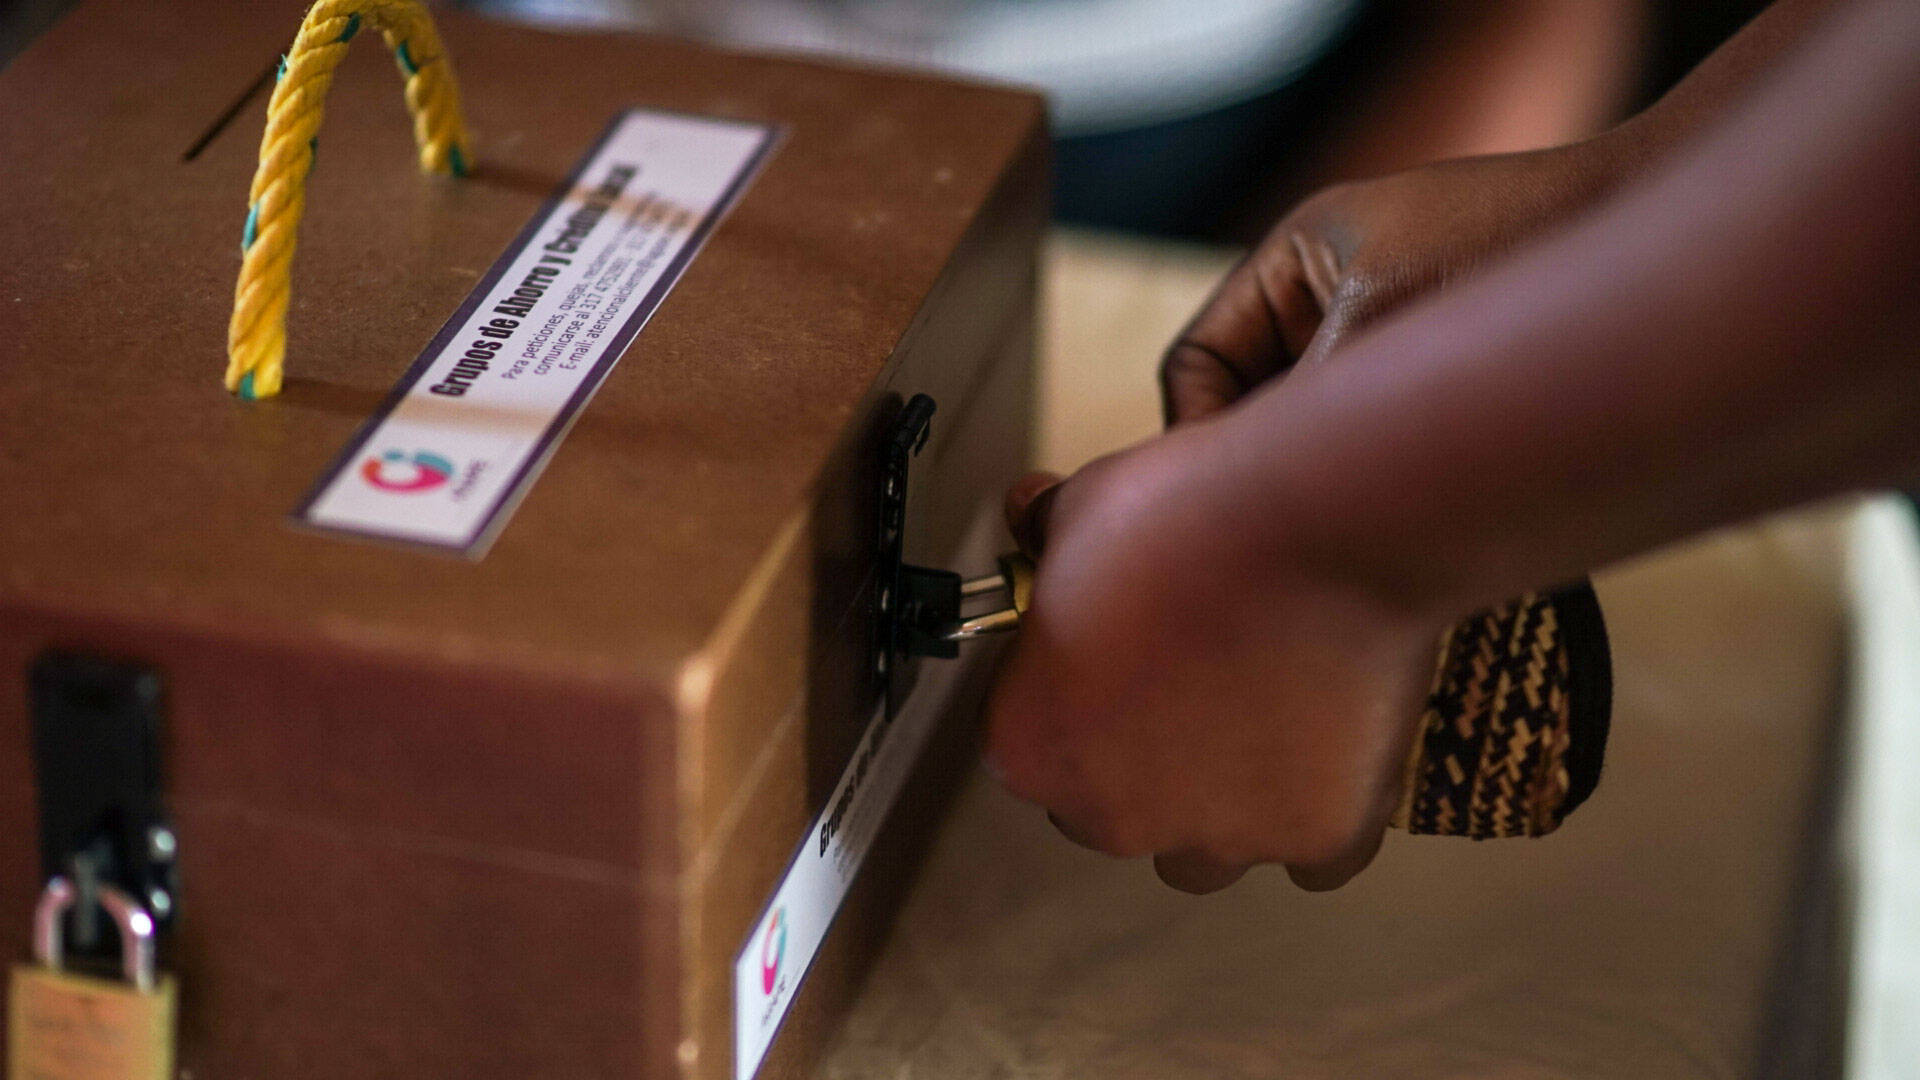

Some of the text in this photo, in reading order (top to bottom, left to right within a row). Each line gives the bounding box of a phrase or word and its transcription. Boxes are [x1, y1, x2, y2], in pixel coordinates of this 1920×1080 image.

[538, 255, 572, 266] y
[493, 266, 561, 318] Ahorro
[579, 293, 601, 310] 317
[477, 318, 520, 339] de
[574, 310, 590, 321] al
[501, 360, 529, 380] Para
[522, 312, 569, 360] peticiones,
[534, 319, 584, 375] comunicarse
[558, 339, 595, 371] E-mail:
[429, 340, 504, 397] Grupos
